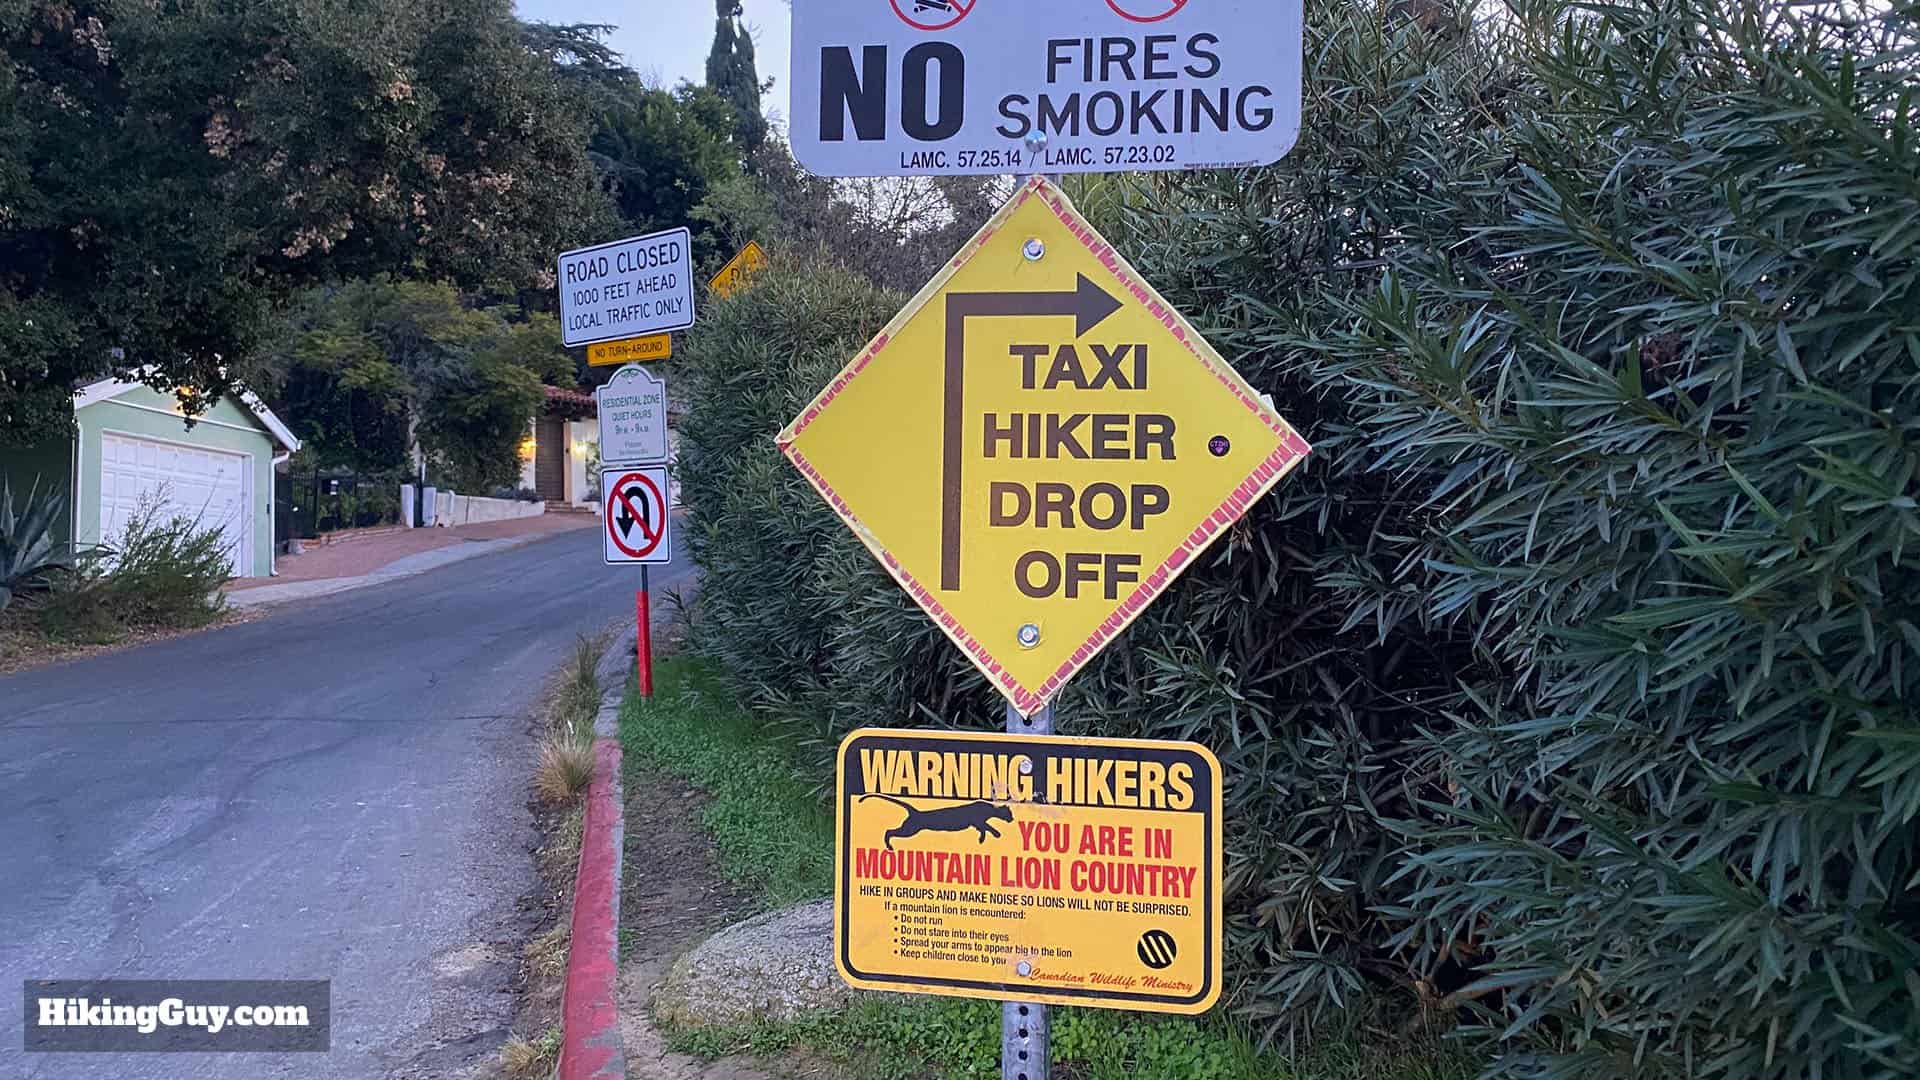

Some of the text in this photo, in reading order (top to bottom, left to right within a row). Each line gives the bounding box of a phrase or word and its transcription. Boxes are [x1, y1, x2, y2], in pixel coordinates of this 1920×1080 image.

[1046, 32, 1222, 84] FIRES
[819, 41, 965, 142] NO
[996, 85, 1274, 140] SMOKING
[901, 151, 950, 169] LAMC.
[957, 149, 1022, 168] 57.25.14
[1044, 147, 1097, 166] LAMC.
[1103, 145, 1176, 165] 57.23.02
[567, 241, 681, 284] ROAD CLOSED
[573, 272, 677, 307] 1000 FEET AHEAD
[569, 296, 684, 331] LOCAL TRAFFIC ONLY
[1009, 344, 1148, 390] TAXI
[602, 393, 660, 409] RESIDENTIAL ZONE
[983, 412, 1176, 460] HIKER
[989, 481, 1171, 531] DROP
[1014, 550, 1142, 601] OFF
[859, 748, 1195, 811] WARNING HIKERS
[1018, 820, 1173, 859] YOU ARE IN
[855, 847, 1197, 899] MOUNTAIN LION COUNTRY
[860, 885, 1192, 917] HIKE IN GROUPS AND MAKE NOISE SO LIONS WILL NOT BE SURPRISED.
[884, 901, 1027, 920] If a mountain lion is encountered:
[901, 914, 943, 926] Do not run
[901, 925, 1009, 943] Do not stare into their eyes
[900, 936, 1072, 957] Spread your arms to appear big to the lion
[900, 949, 1007, 966] Keep children close to you
[1030, 967, 1193, 992] Canadian Wildlife Ministry
